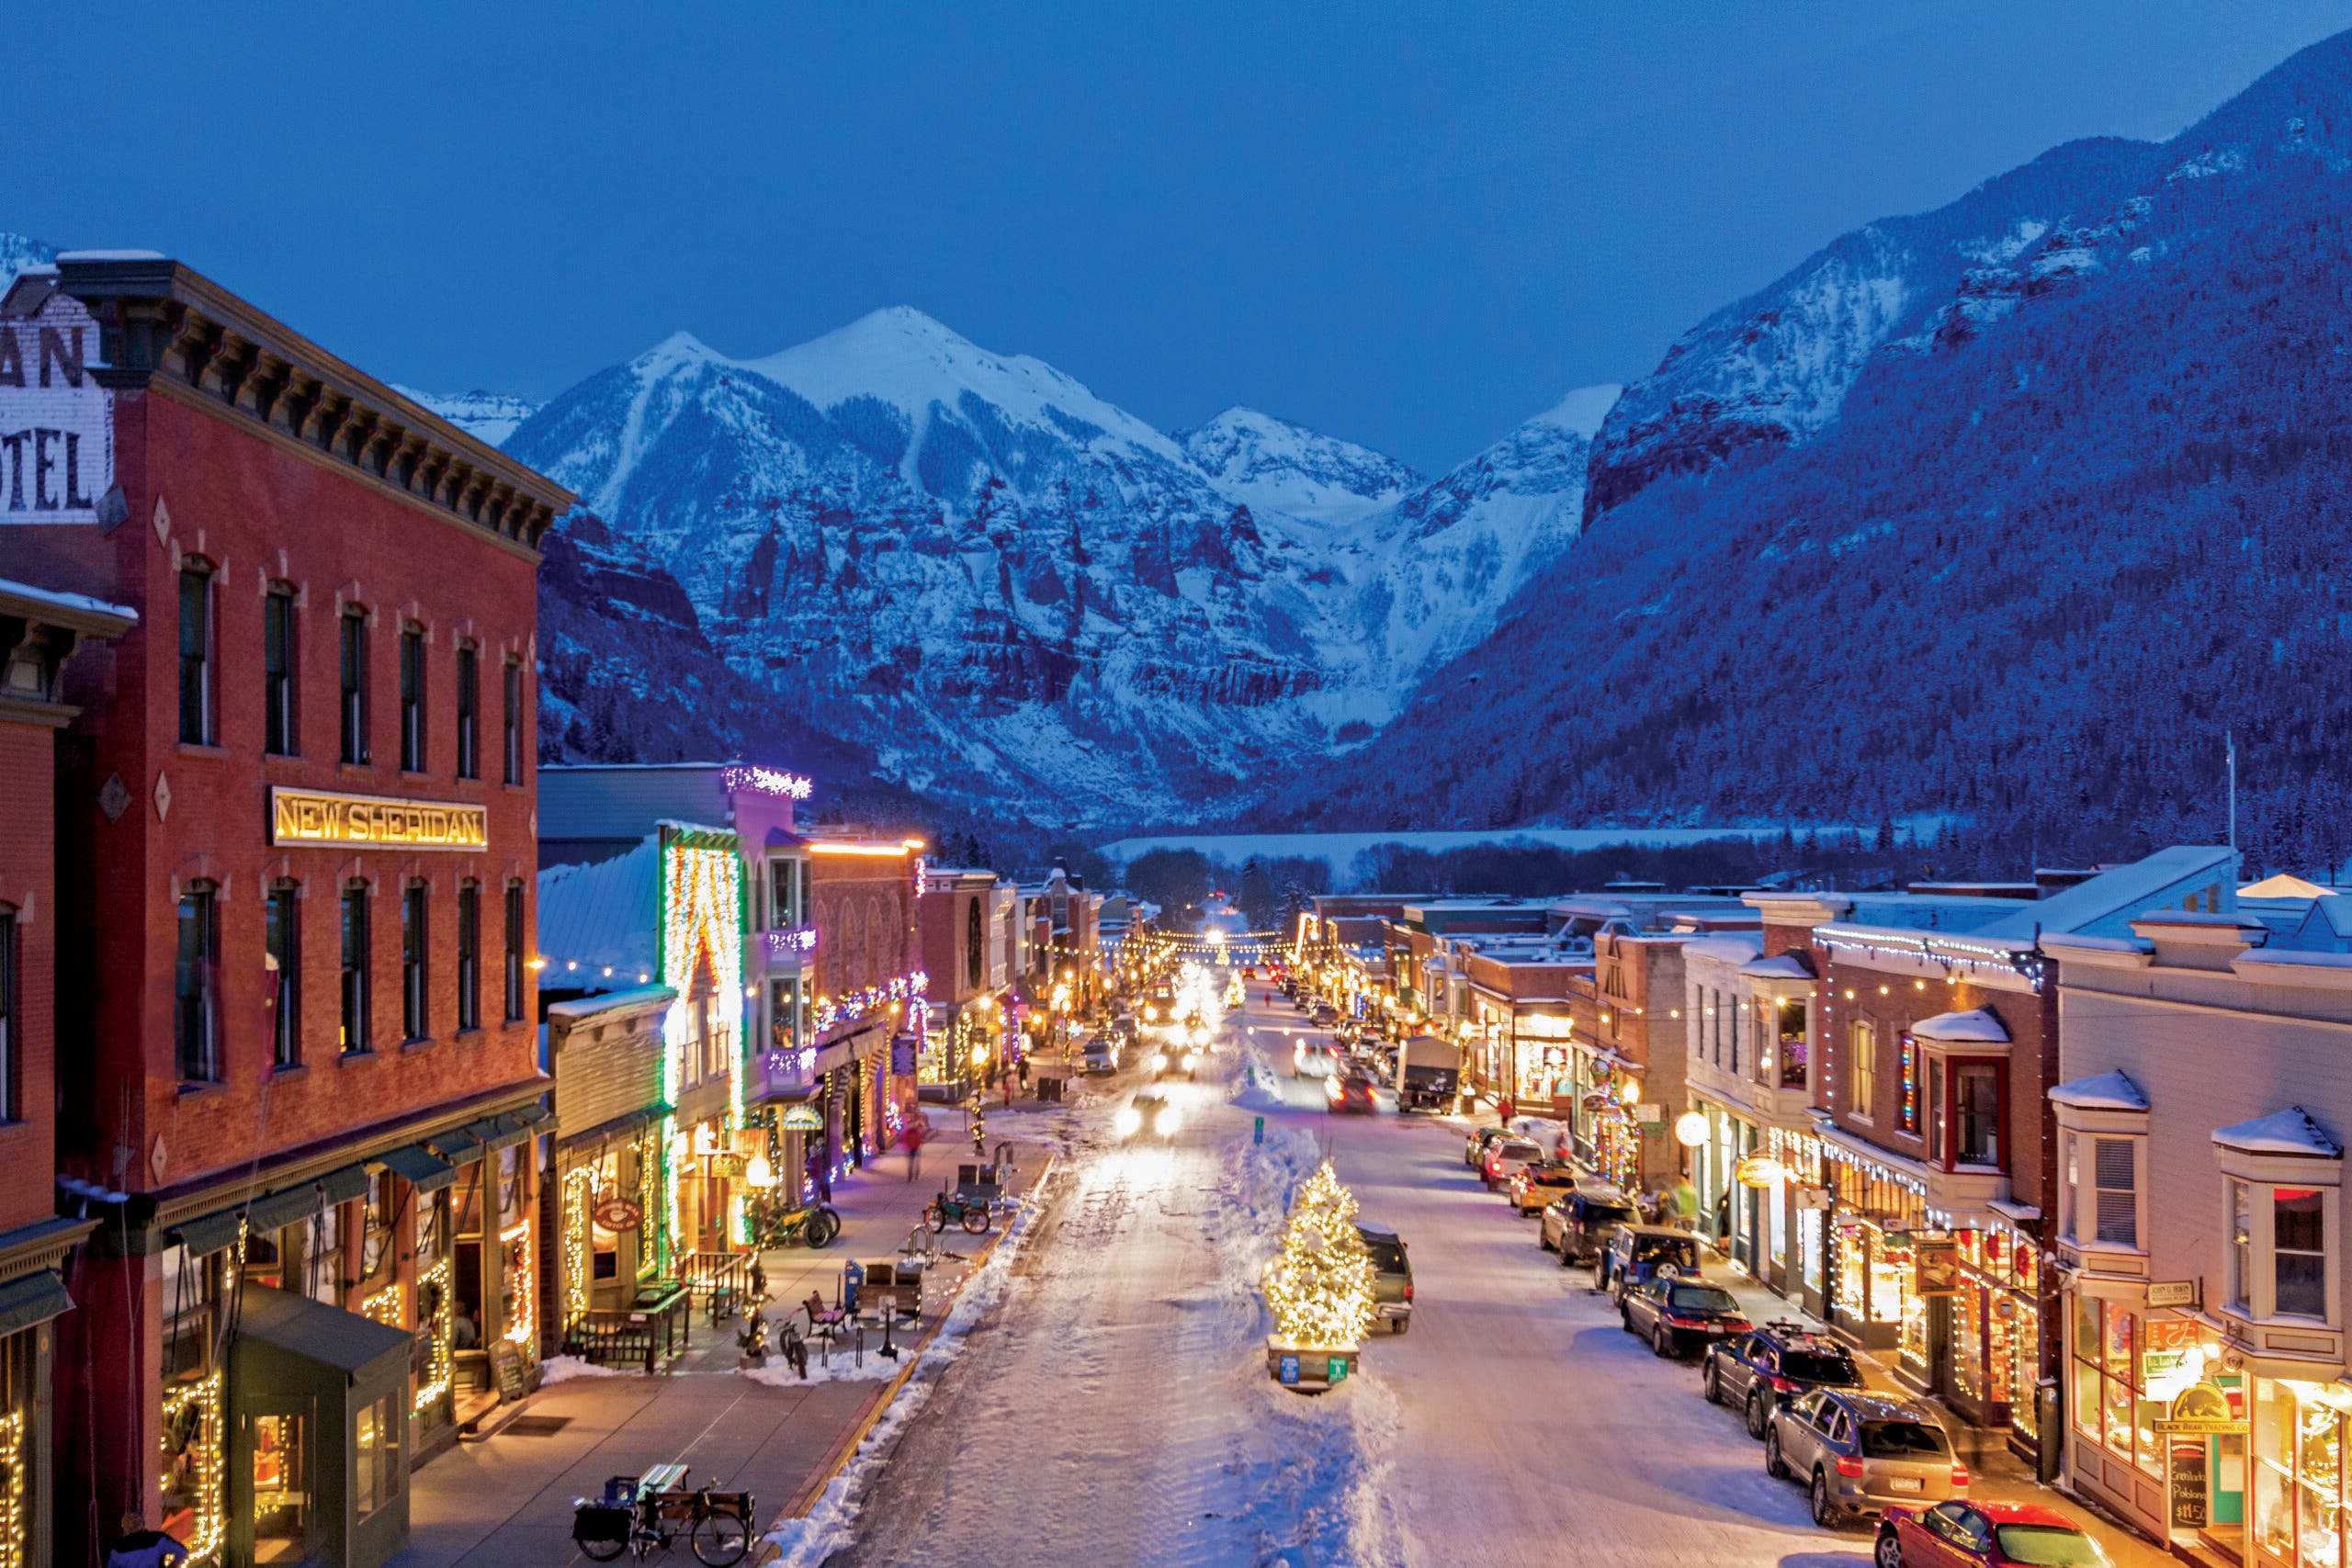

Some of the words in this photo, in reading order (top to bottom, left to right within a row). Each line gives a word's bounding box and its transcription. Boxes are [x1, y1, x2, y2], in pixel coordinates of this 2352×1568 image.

[0, 427, 93, 511] TEL
[276, 798, 342, 839] NEW
[348, 804, 482, 844] SHERIDAN
[2156, 1423, 2181, 1431] BLACK
